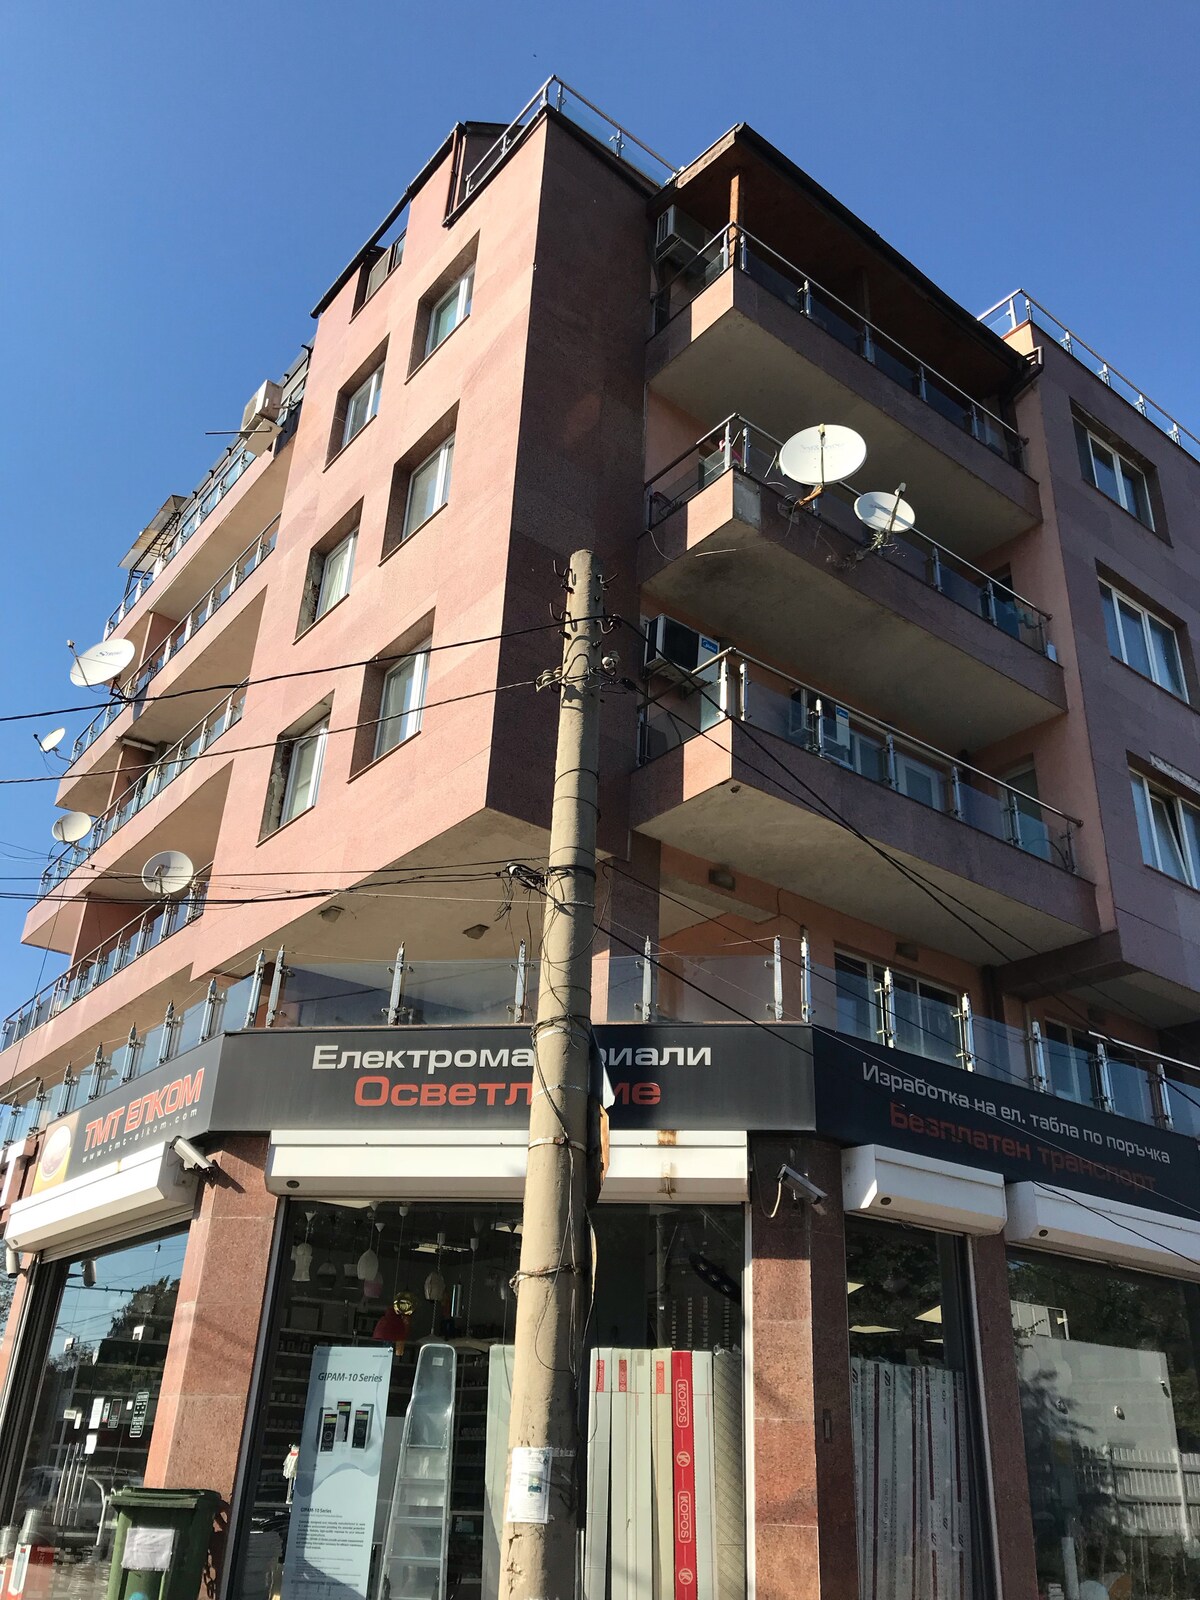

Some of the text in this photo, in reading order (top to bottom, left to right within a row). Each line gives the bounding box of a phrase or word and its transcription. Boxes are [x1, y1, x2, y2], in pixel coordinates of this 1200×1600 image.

[312, 1045, 712, 1075] Електромаиали
[124, 1067, 205, 1134] ЕЛКОМ
[354, 1076, 662, 1107] Осветлие
[862, 1061, 1171, 1164] Изработка на ел. табла по поръчка
[889, 1101, 1156, 1191] Безплатен транспорт
[318, 1372, 383, 1382] GIPAM-10 Series
[678, 1383, 687, 1423] KOPOS
[681, 1495, 690, 1538] KOPOS
